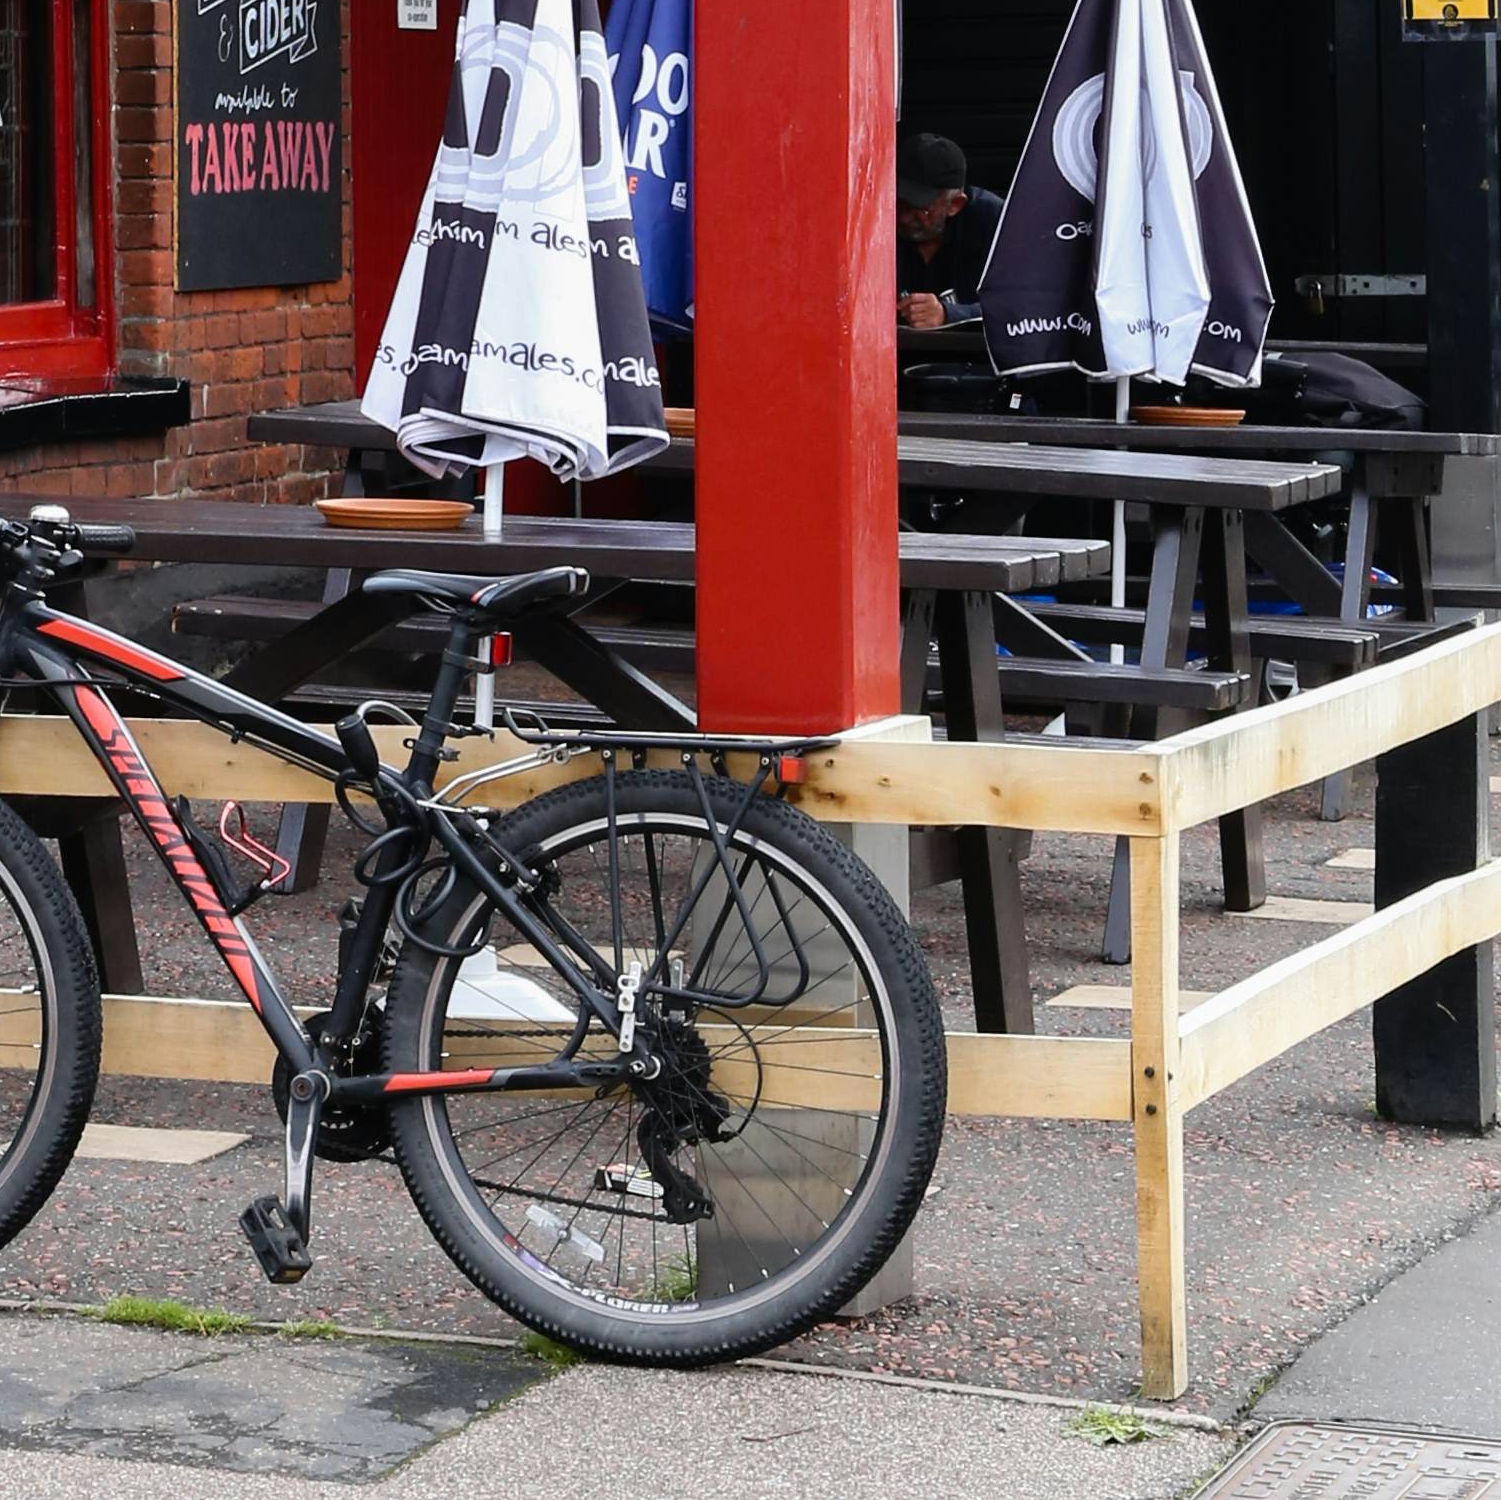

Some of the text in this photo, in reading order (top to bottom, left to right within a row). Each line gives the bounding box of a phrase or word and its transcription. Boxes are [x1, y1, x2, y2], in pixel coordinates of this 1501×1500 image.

[217, 12, 234, 63] &
[280, 82, 299, 109] to
[185, 120, 335, 196] TAKE AWAY
